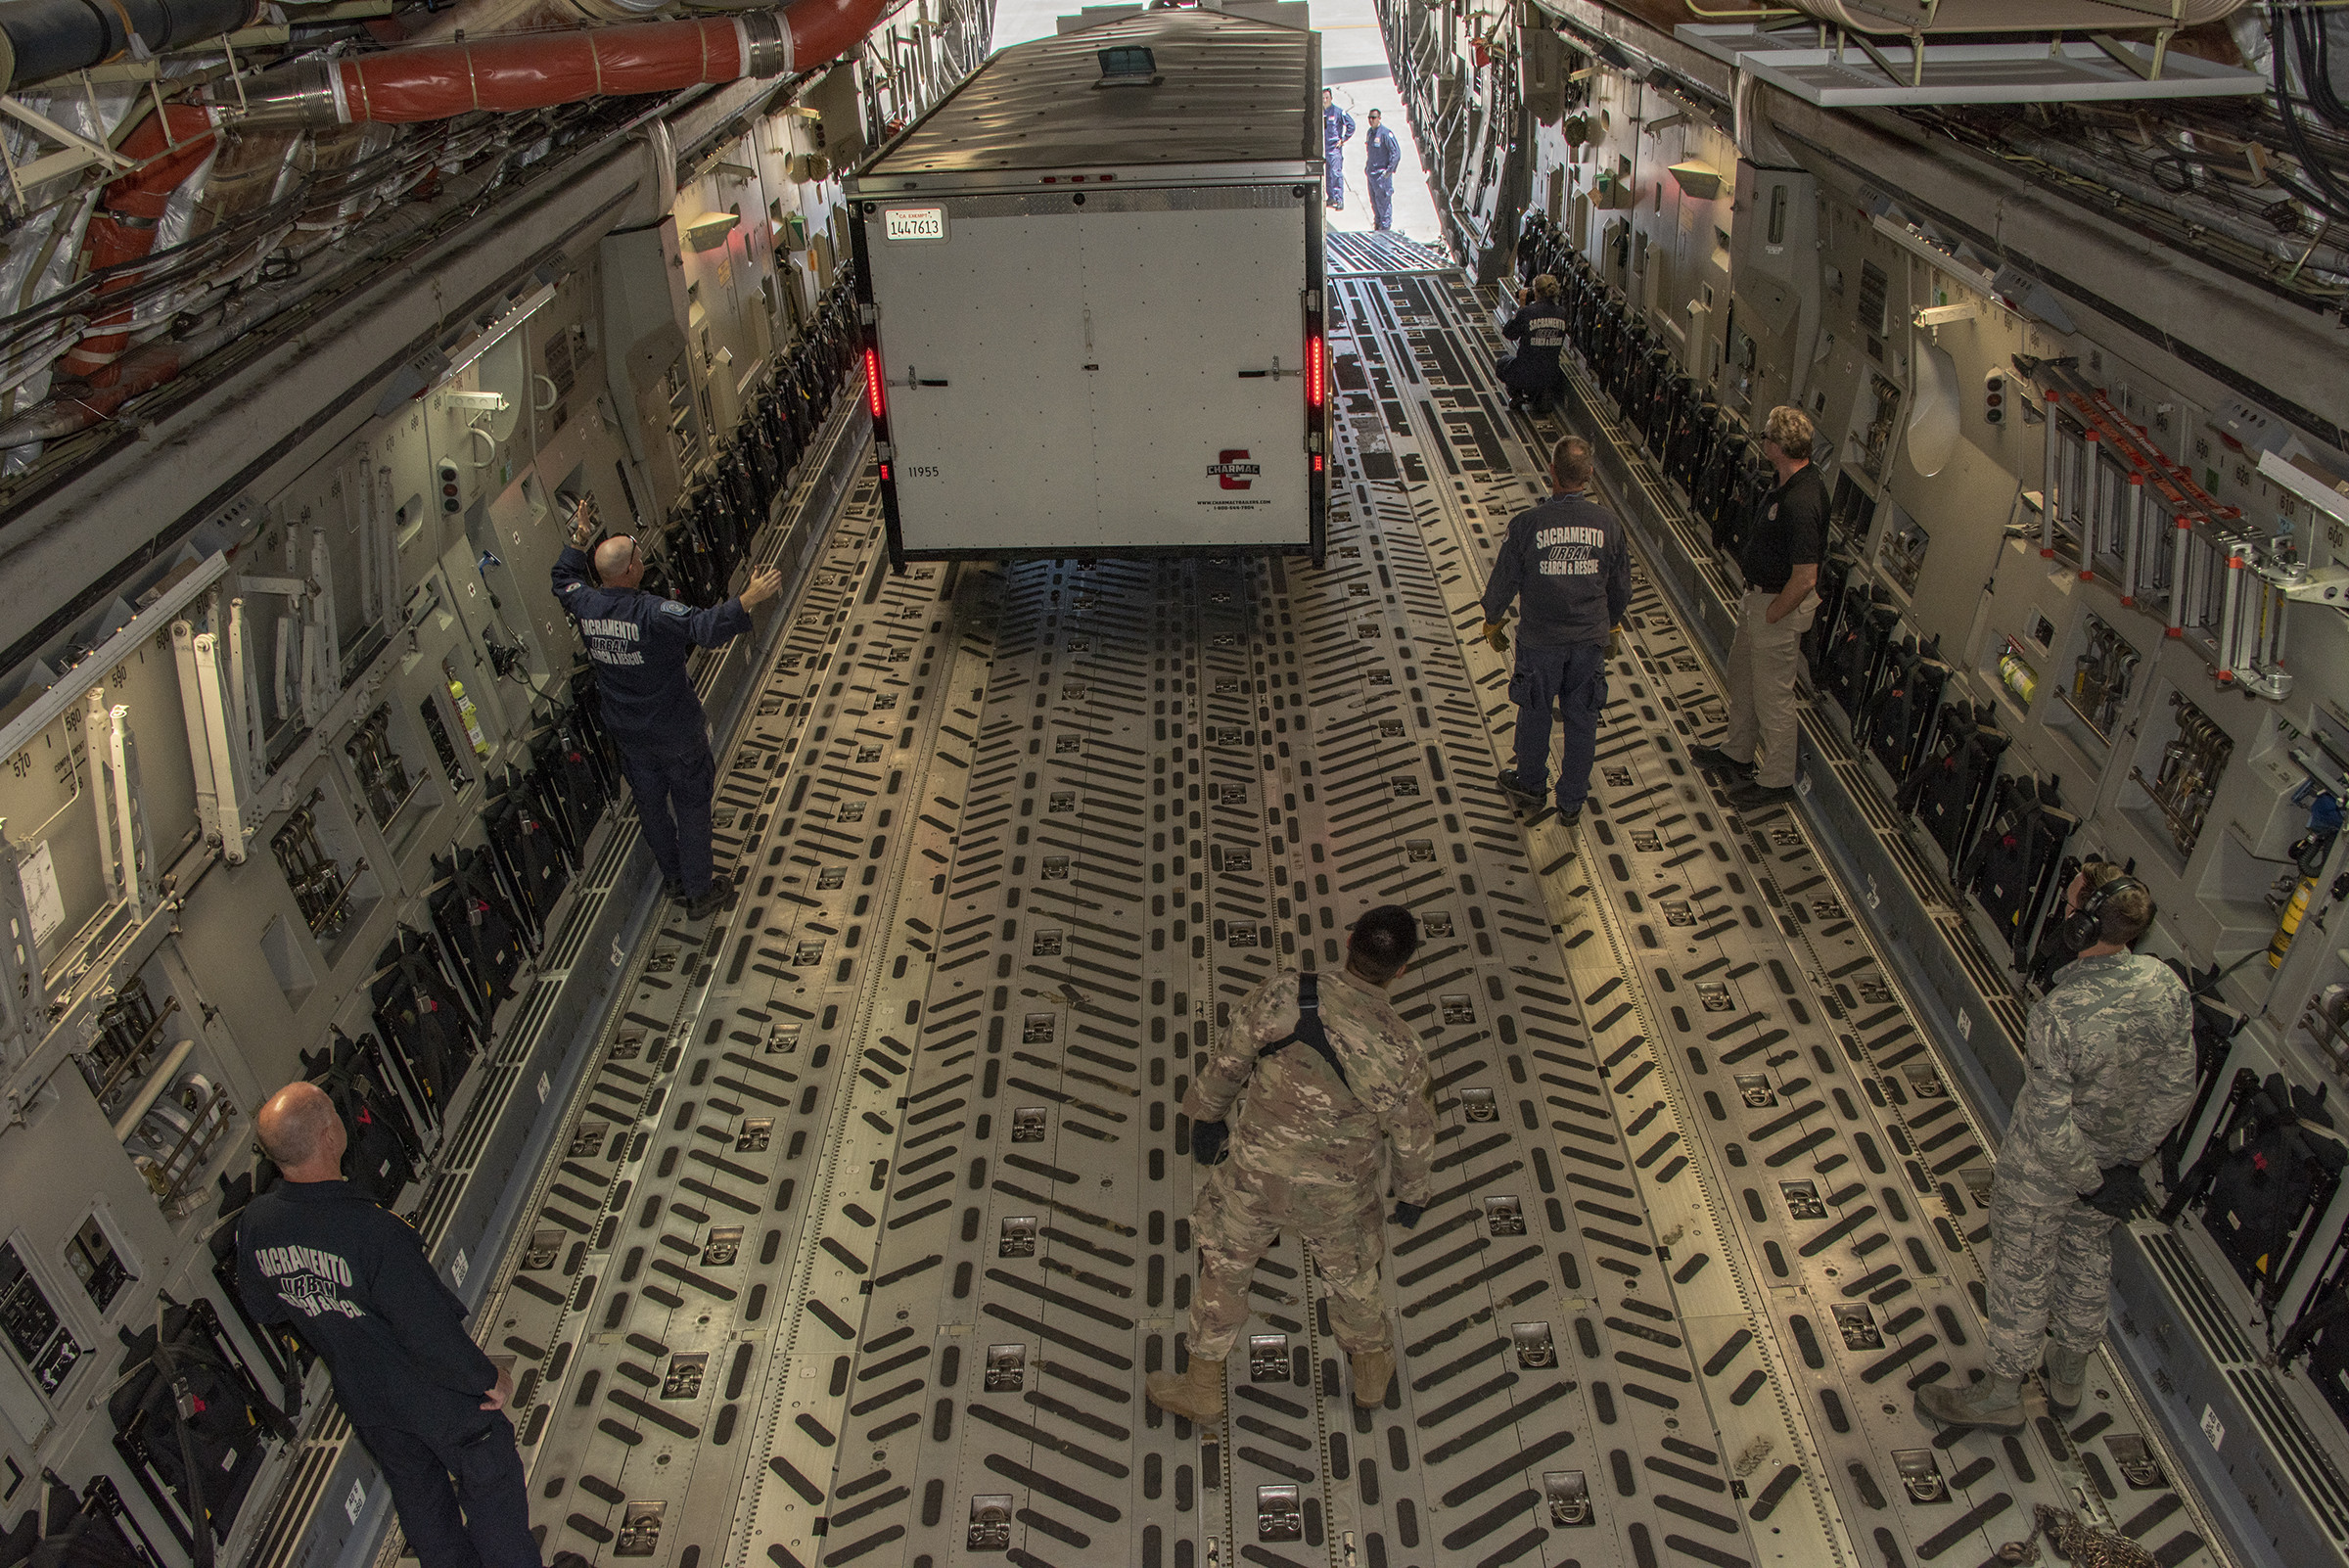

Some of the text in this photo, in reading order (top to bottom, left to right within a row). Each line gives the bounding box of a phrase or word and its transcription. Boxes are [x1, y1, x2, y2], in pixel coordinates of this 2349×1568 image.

[891, 220, 940, 236] 1447613
[908, 466, 940, 478] 11955
[1207, 464, 1260, 476] CHARMAC
[2280, 495, 2295, 516] 610
[1536, 527, 1604, 549] SACRAMENTO
[2328, 527, 2344, 547] 600
[1548, 546, 1592, 561] URBAN
[1539, 559, 1600, 576] SEARCH & RESCUE
[198, 594, 209, 615] 610
[157, 627, 170, 649] 600
[592, 637, 628, 653] URBAN
[112, 666, 127, 688] 590
[65, 708, 82, 732] 580
[13, 752, 31, 778] 570
[69, 776, 84, 797] 58
[254, 1244, 353, 1288] SACRAMENTO
[347, 1492, 355, 1507] AD
[352, 1498, 363, 1518] 560
